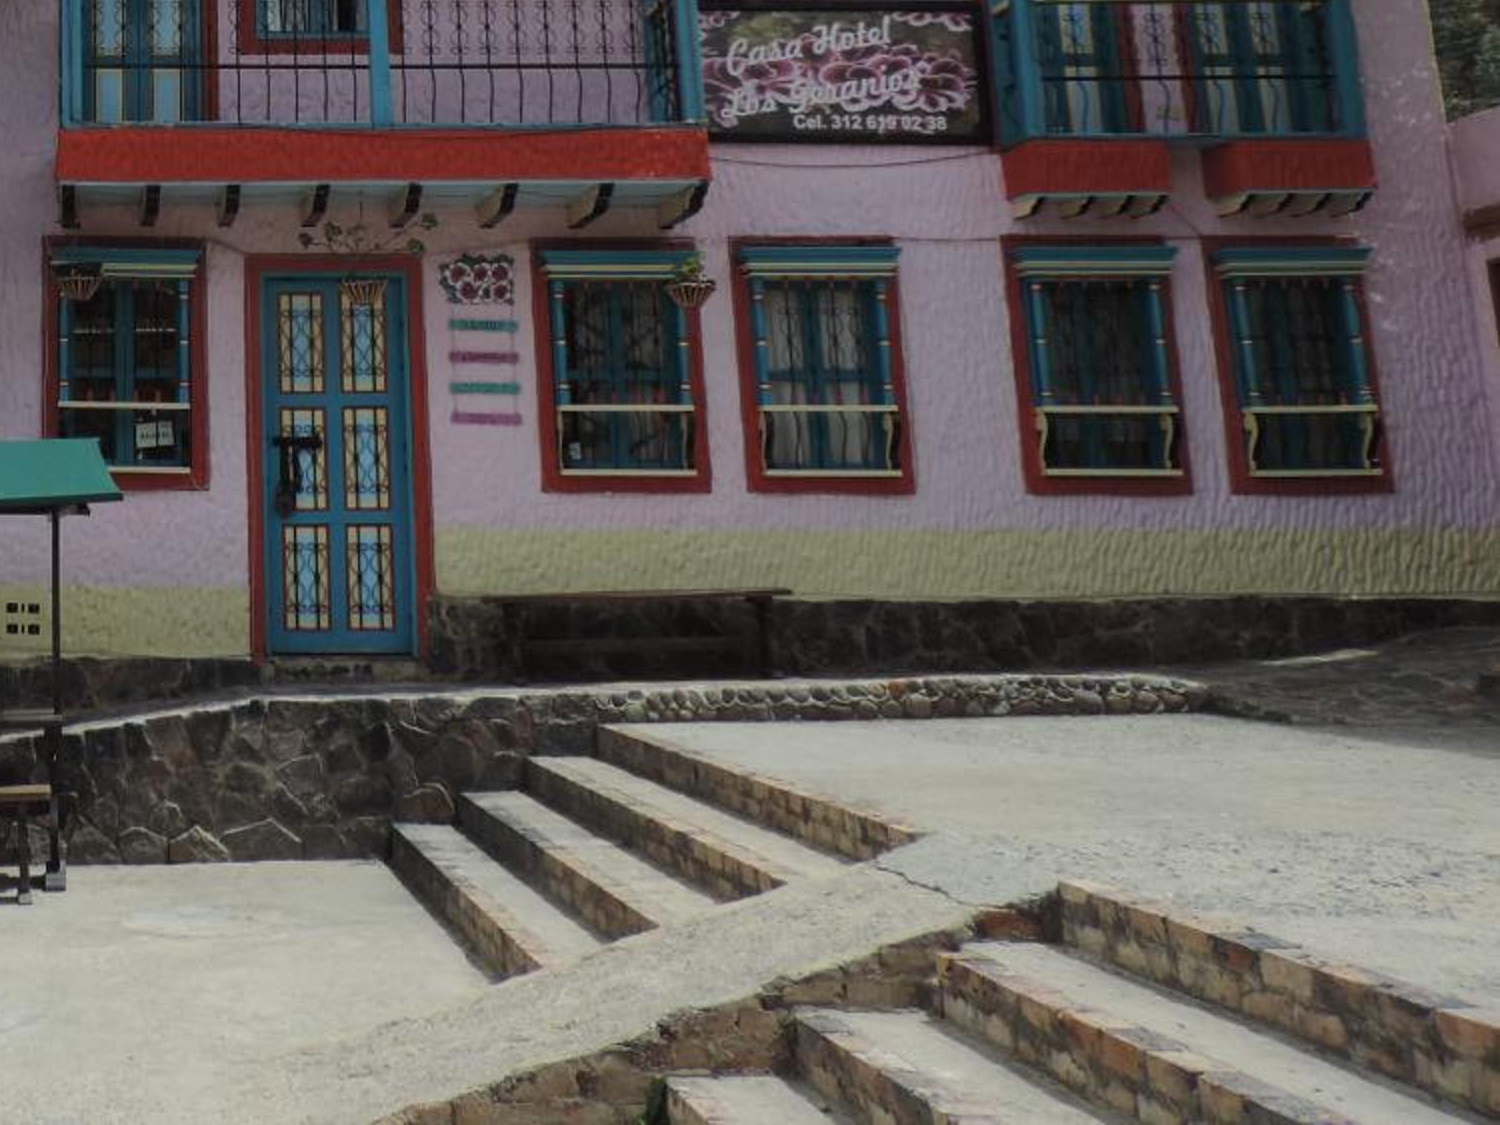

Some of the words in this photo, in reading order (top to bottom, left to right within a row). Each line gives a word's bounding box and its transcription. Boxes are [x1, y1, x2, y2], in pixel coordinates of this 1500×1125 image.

[726, 37, 804, 76] Casa
[811, 14, 892, 55] Hotel
[721, 79, 777, 118] Los
[792, 114, 827, 130] Cel.
[831, 114, 863, 130] 312
[900, 115, 923, 131] 02
[928, 115, 948, 131] 38
